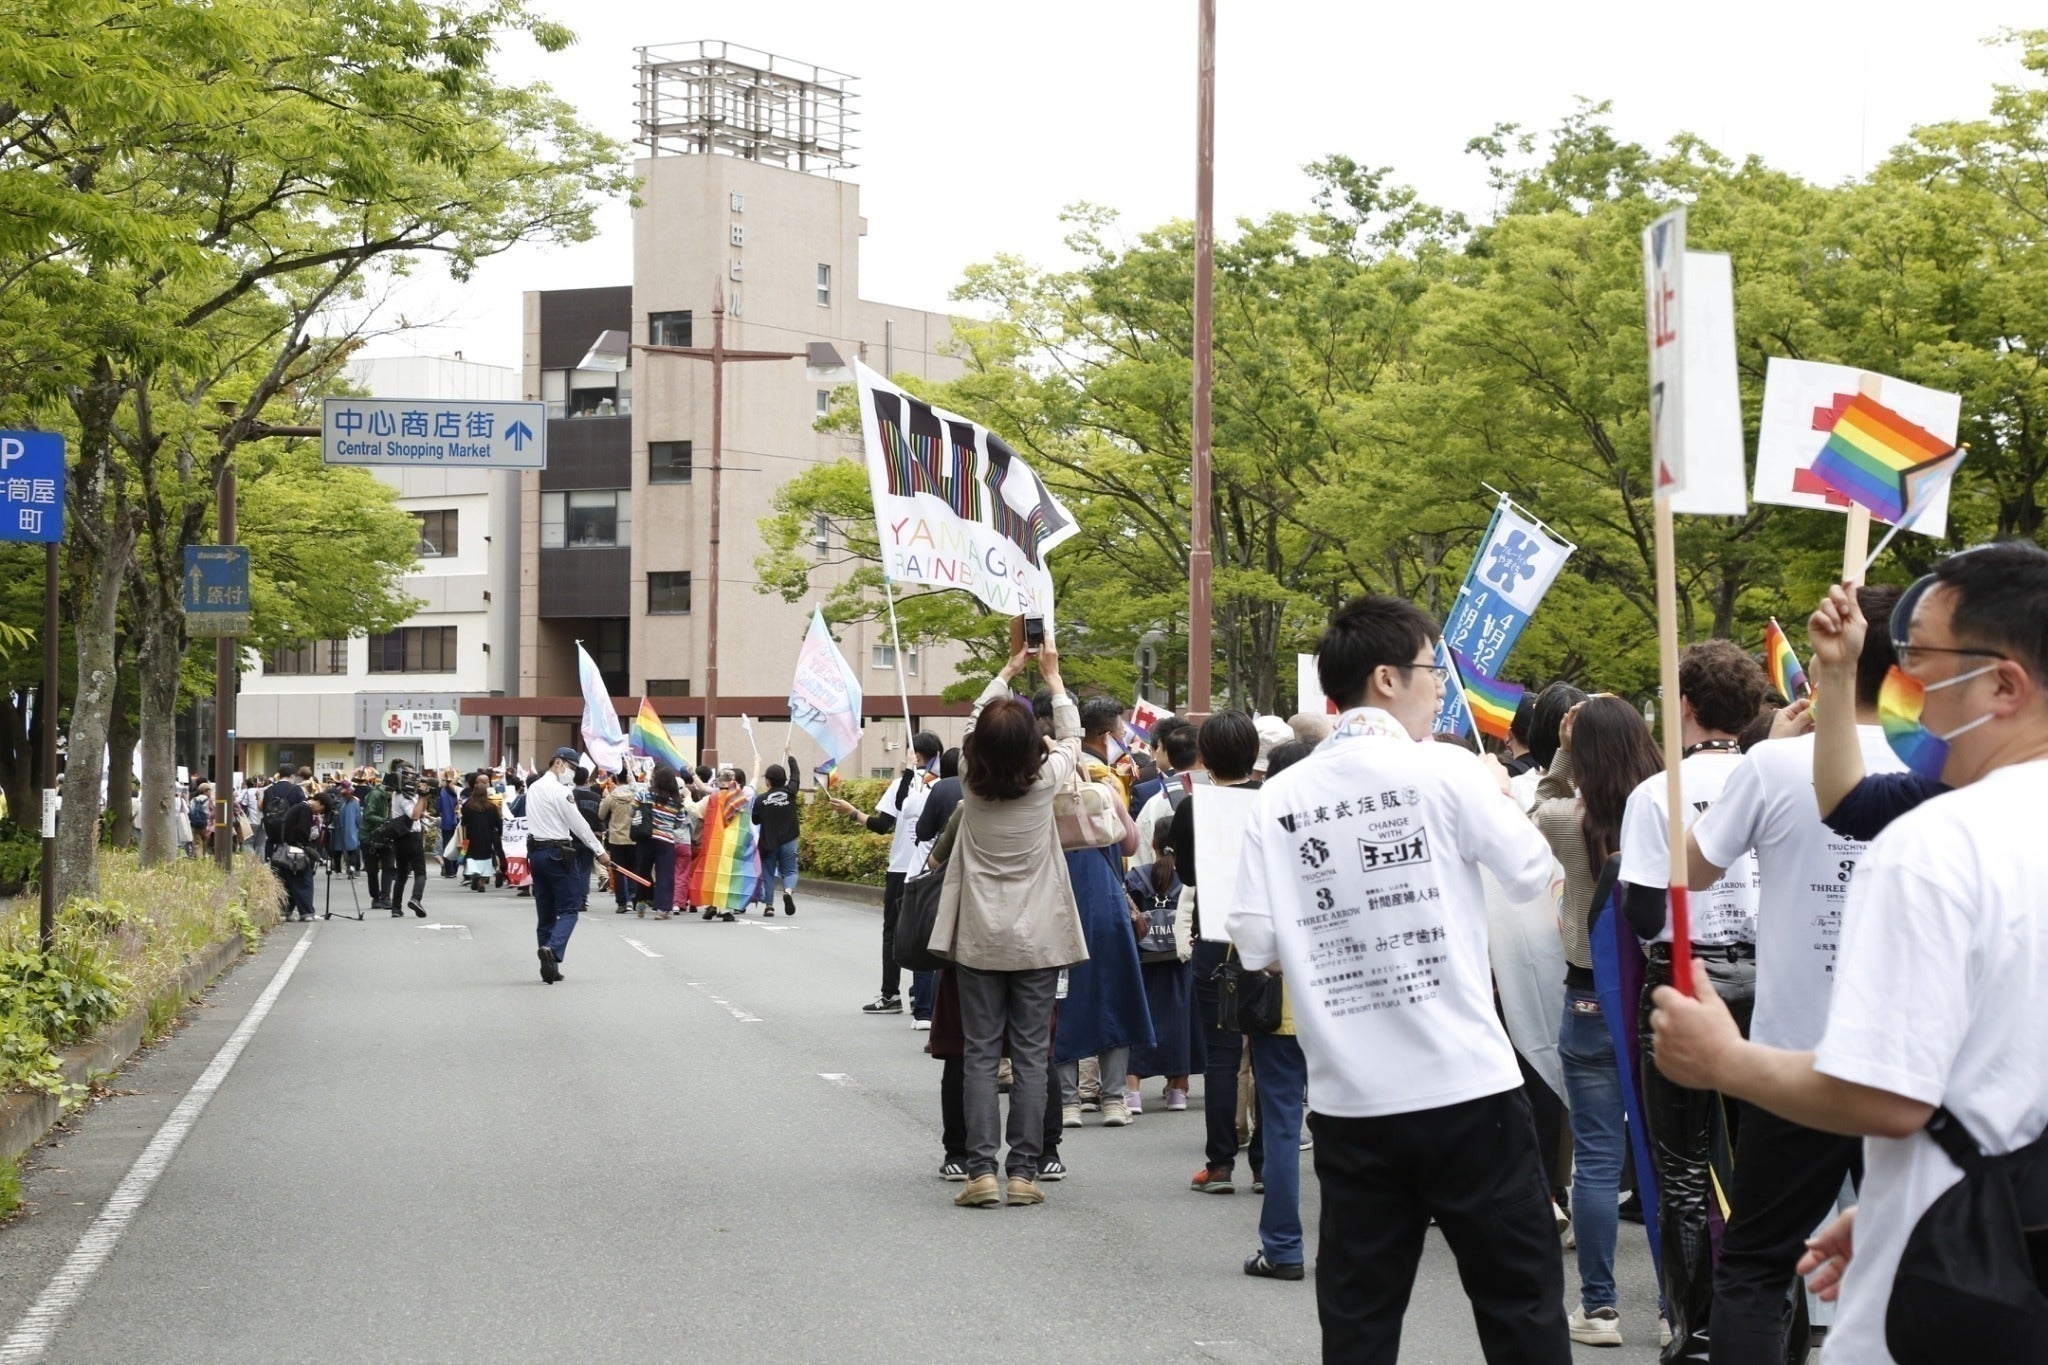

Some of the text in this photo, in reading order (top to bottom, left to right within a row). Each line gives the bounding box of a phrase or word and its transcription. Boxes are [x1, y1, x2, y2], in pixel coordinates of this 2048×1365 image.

[335, 408, 494, 438] 中心商店街
[1, 438, 24, 469] P
[337, 440, 491, 459] Central Shopping Market
[20, 508, 43, 533] 町
[207, 585, 243, 605] 原付
[1314, 790, 1402, 823] 東武住販
[1368, 817, 1410, 832] CHANGE
[1378, 829, 1403, 840] WITH
[1363, 837, 1424, 868] チェリオ
[1827, 843, 1868, 852] TSUCHIYA
[1301, 868, 1337, 882] TSUCHIYA
[1315, 887, 1335, 911] 3
[1810, 883, 1847, 893] THREE
[1296, 906, 1361, 928] THREE ARROW
[1375, 925, 1447, 952] みさき歯科
